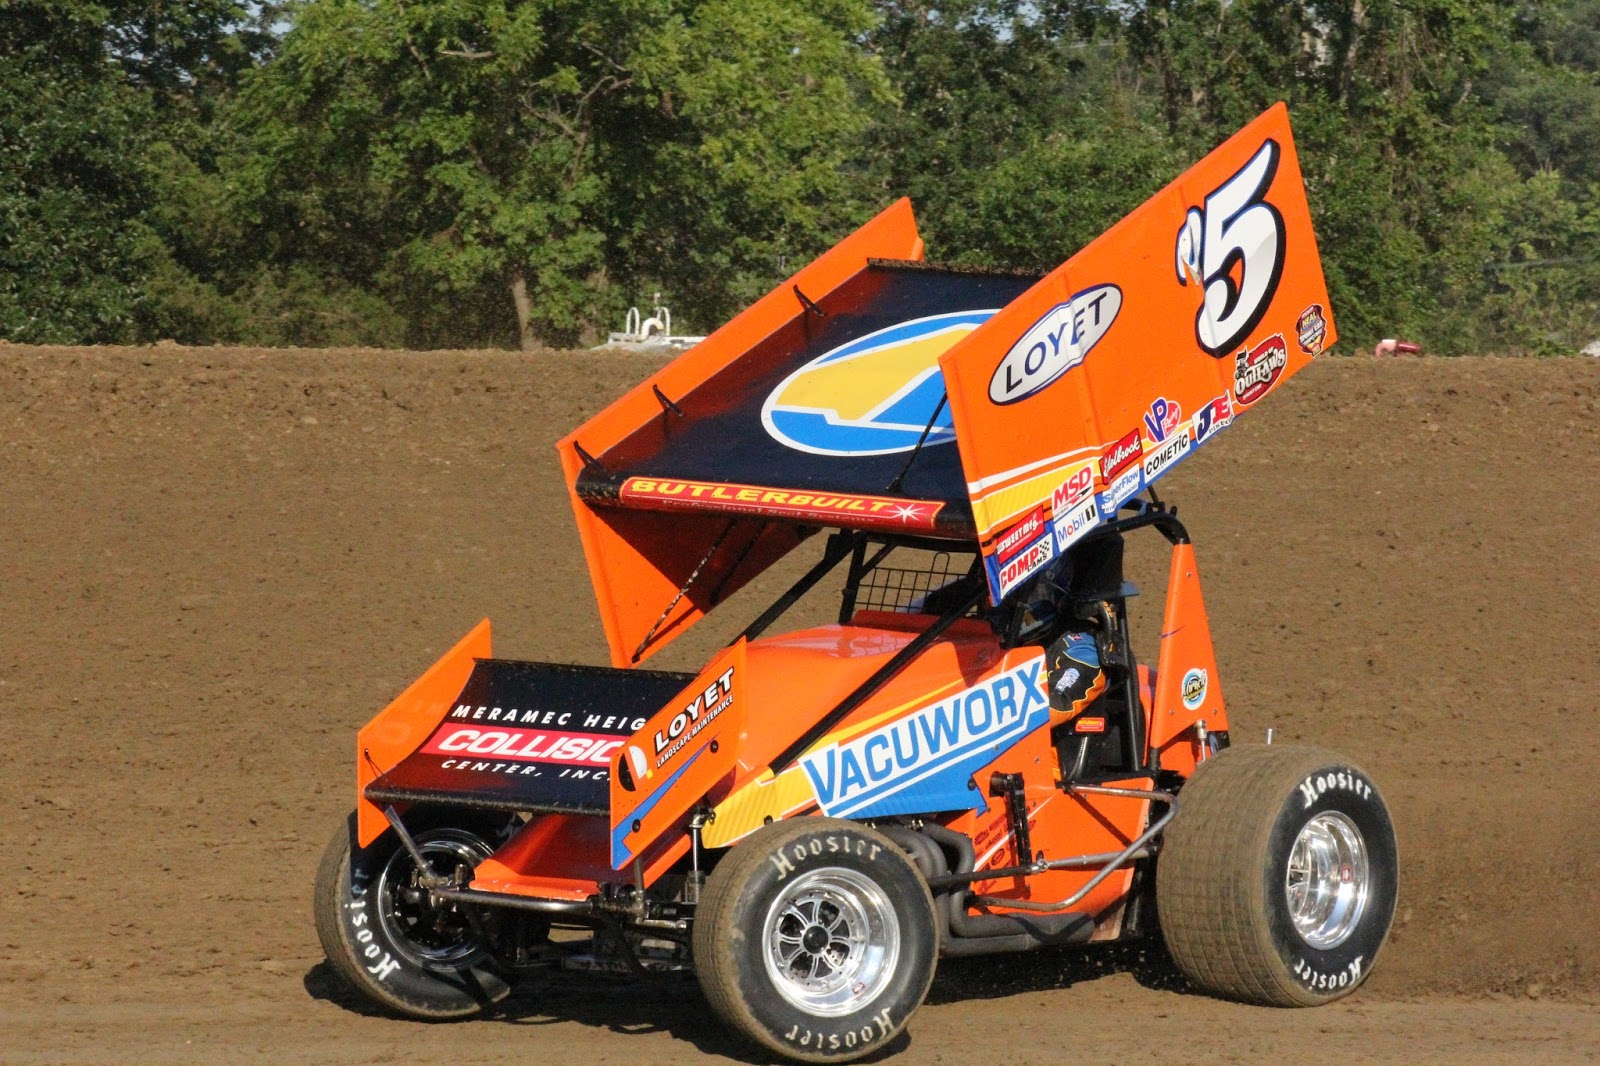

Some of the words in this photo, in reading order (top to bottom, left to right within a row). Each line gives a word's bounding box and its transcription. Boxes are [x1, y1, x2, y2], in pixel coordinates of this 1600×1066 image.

[1005, 292, 1107, 394] LOYET
[1144, 398, 1168, 443] VP
[1197, 396, 1231, 442] JE
[630, 480, 898, 512] BUTLERBUILT
[1053, 466, 1092, 510] MSD
[1057, 511, 1085, 543] Mobil
[1085, 504, 1097, 521] 1
[1000, 546, 1039, 589] COMP
[1027, 554, 1048, 573] CAMS
[452, 705, 571, 726] MERAMEC
[655, 666, 734, 756] LOYET
[657, 732, 691, 768] LANDSCAPE
[691, 695, 733, 738] MAINTENANCE
[804, 661, 1046, 805] VACUWORX
[441, 760, 543, 777] CENTER,
[1300, 770, 1372, 809] Hoosier
[770, 836, 882, 881] Hoosier
[1294, 955, 1363, 991] Hoosier
[784, 1007, 897, 1050] Hoosier
